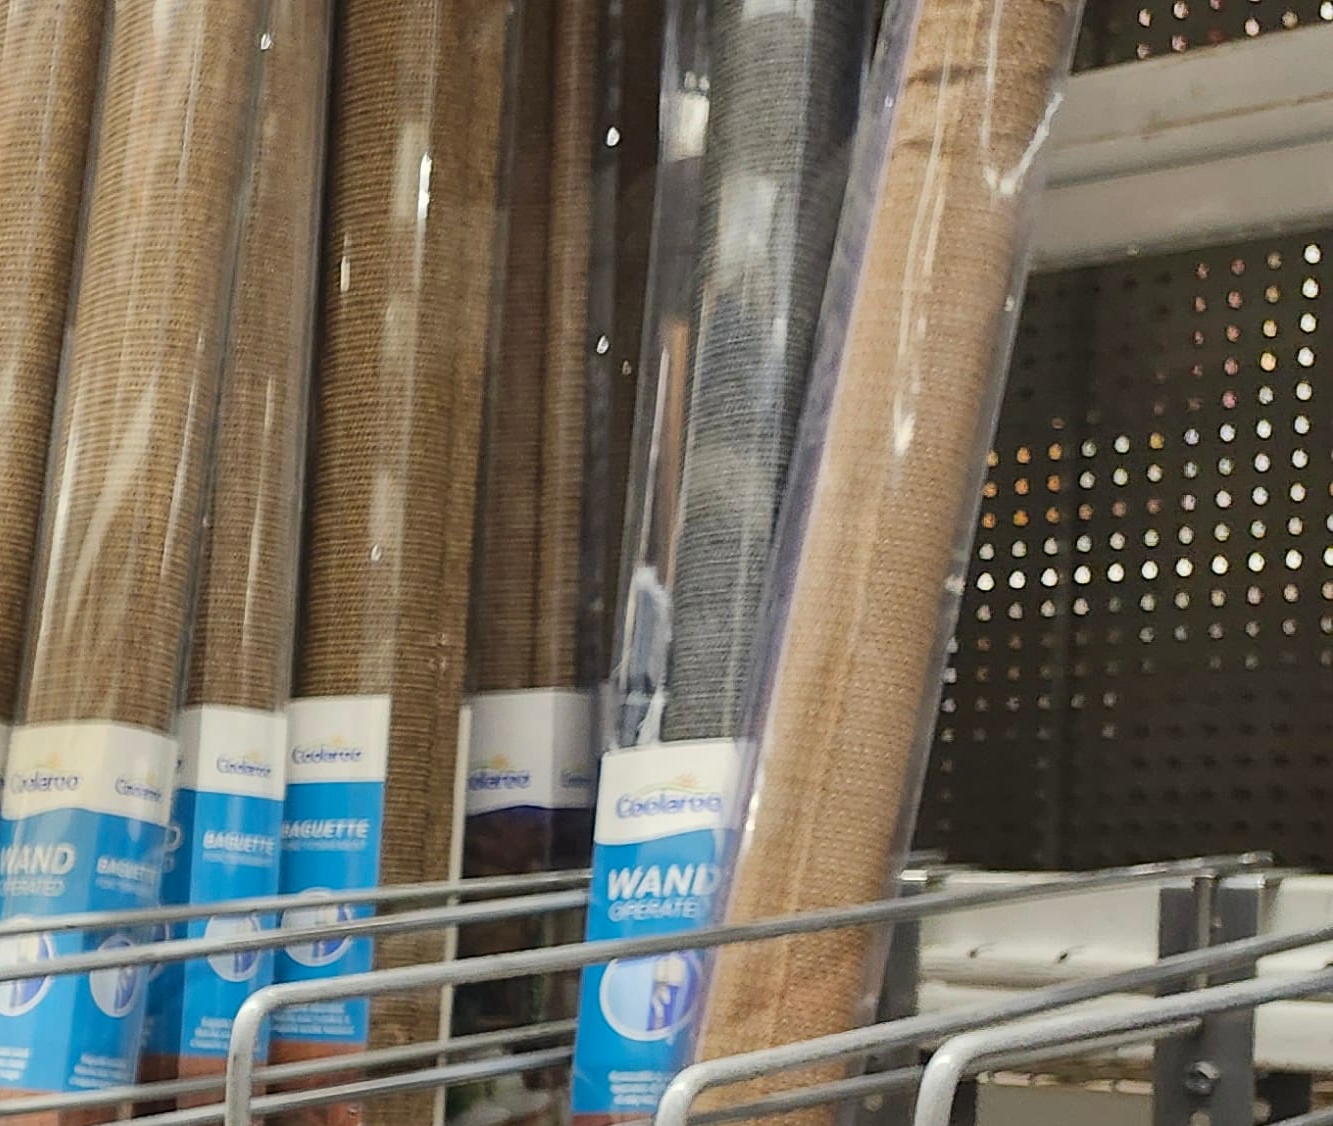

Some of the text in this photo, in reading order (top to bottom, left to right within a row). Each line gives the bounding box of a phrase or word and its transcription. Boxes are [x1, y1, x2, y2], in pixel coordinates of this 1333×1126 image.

[614, 791, 721, 820] Coolaroo
[0, 842, 76, 876] WAND
[607, 863, 721, 900] WAND
